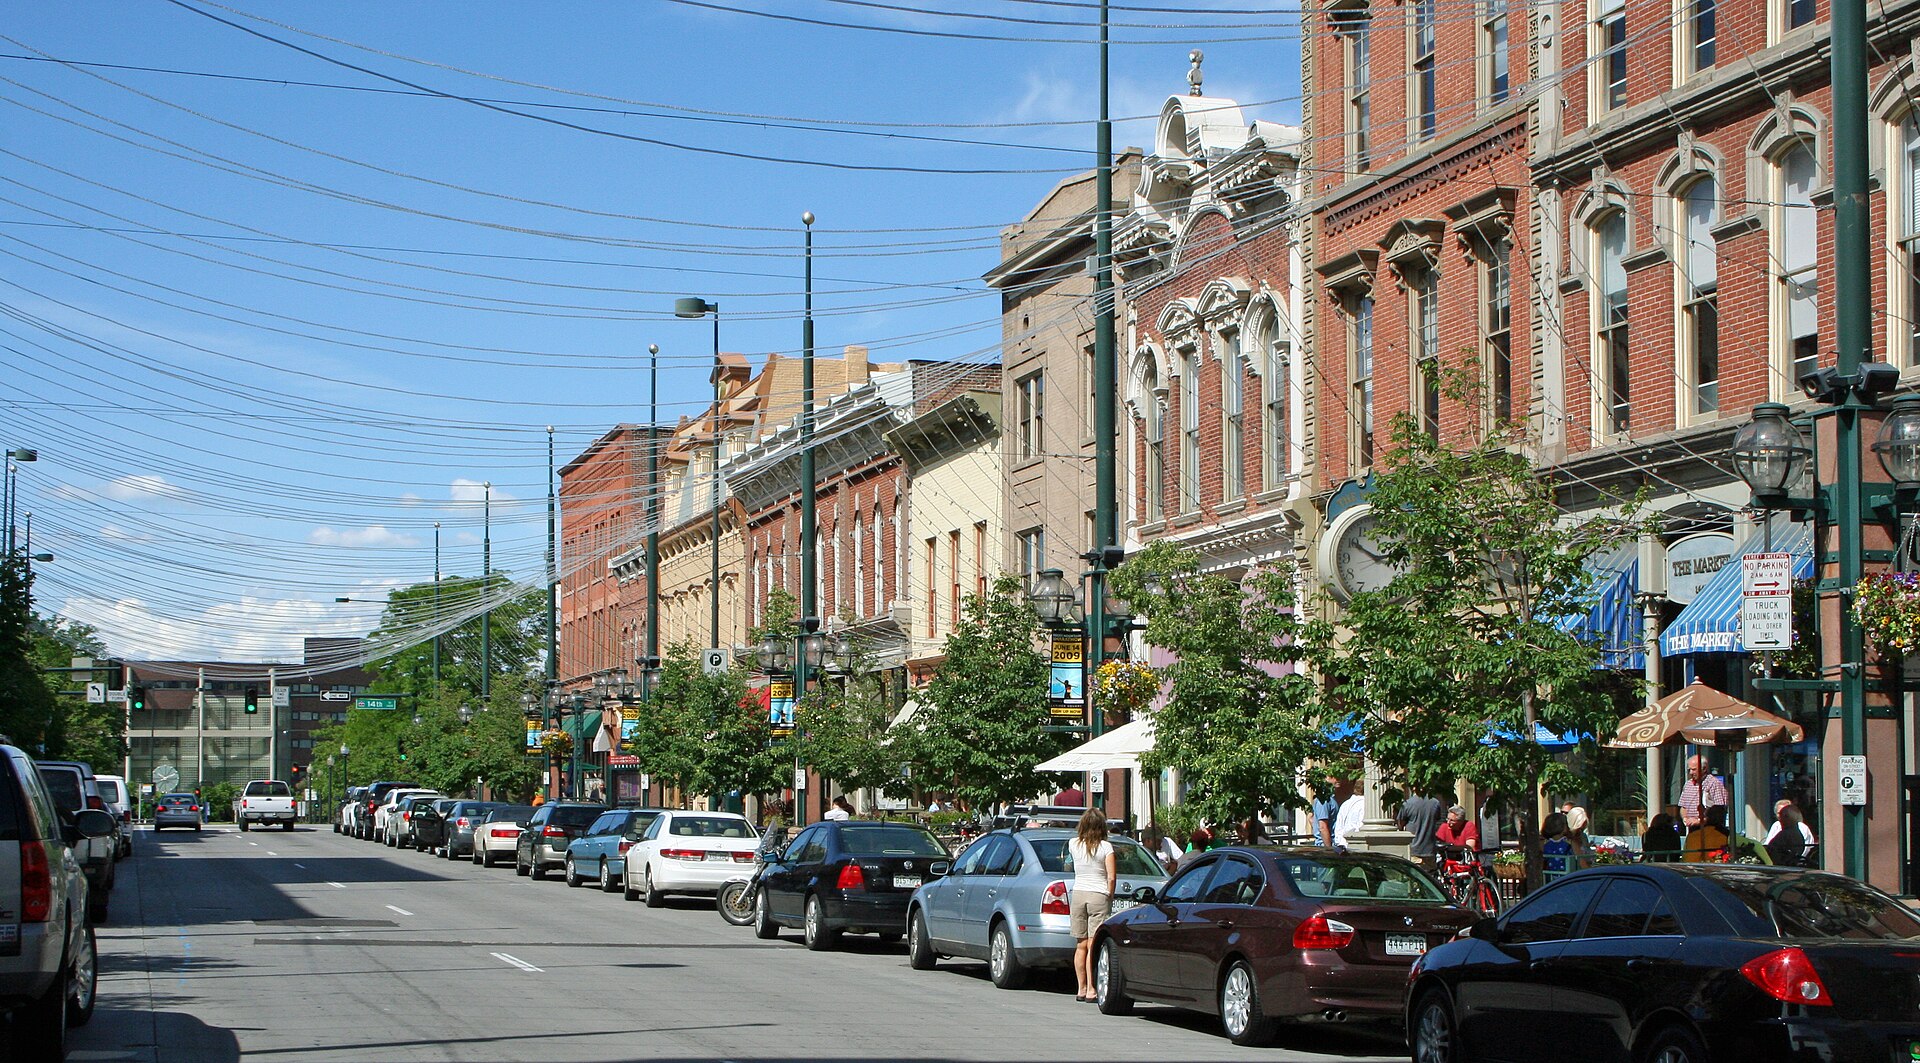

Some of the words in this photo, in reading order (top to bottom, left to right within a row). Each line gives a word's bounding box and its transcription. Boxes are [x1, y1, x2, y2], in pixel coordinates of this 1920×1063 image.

[1342, 553, 1351, 564] 9
[1672, 560, 1692, 576] THE
[1744, 562, 1754, 570] NO
[1758, 562, 1788, 570] PARKING
[1346, 568, 1354, 580] 8
[1356, 582, 1365, 592] 7
[1670, 635, 1689, 651] THE
[1691, 632, 1734, 648] MARKET
[713, 656, 720, 665] P
[1054, 651, 1080, 660] 2009
[1844, 778, 1851, 787] P
